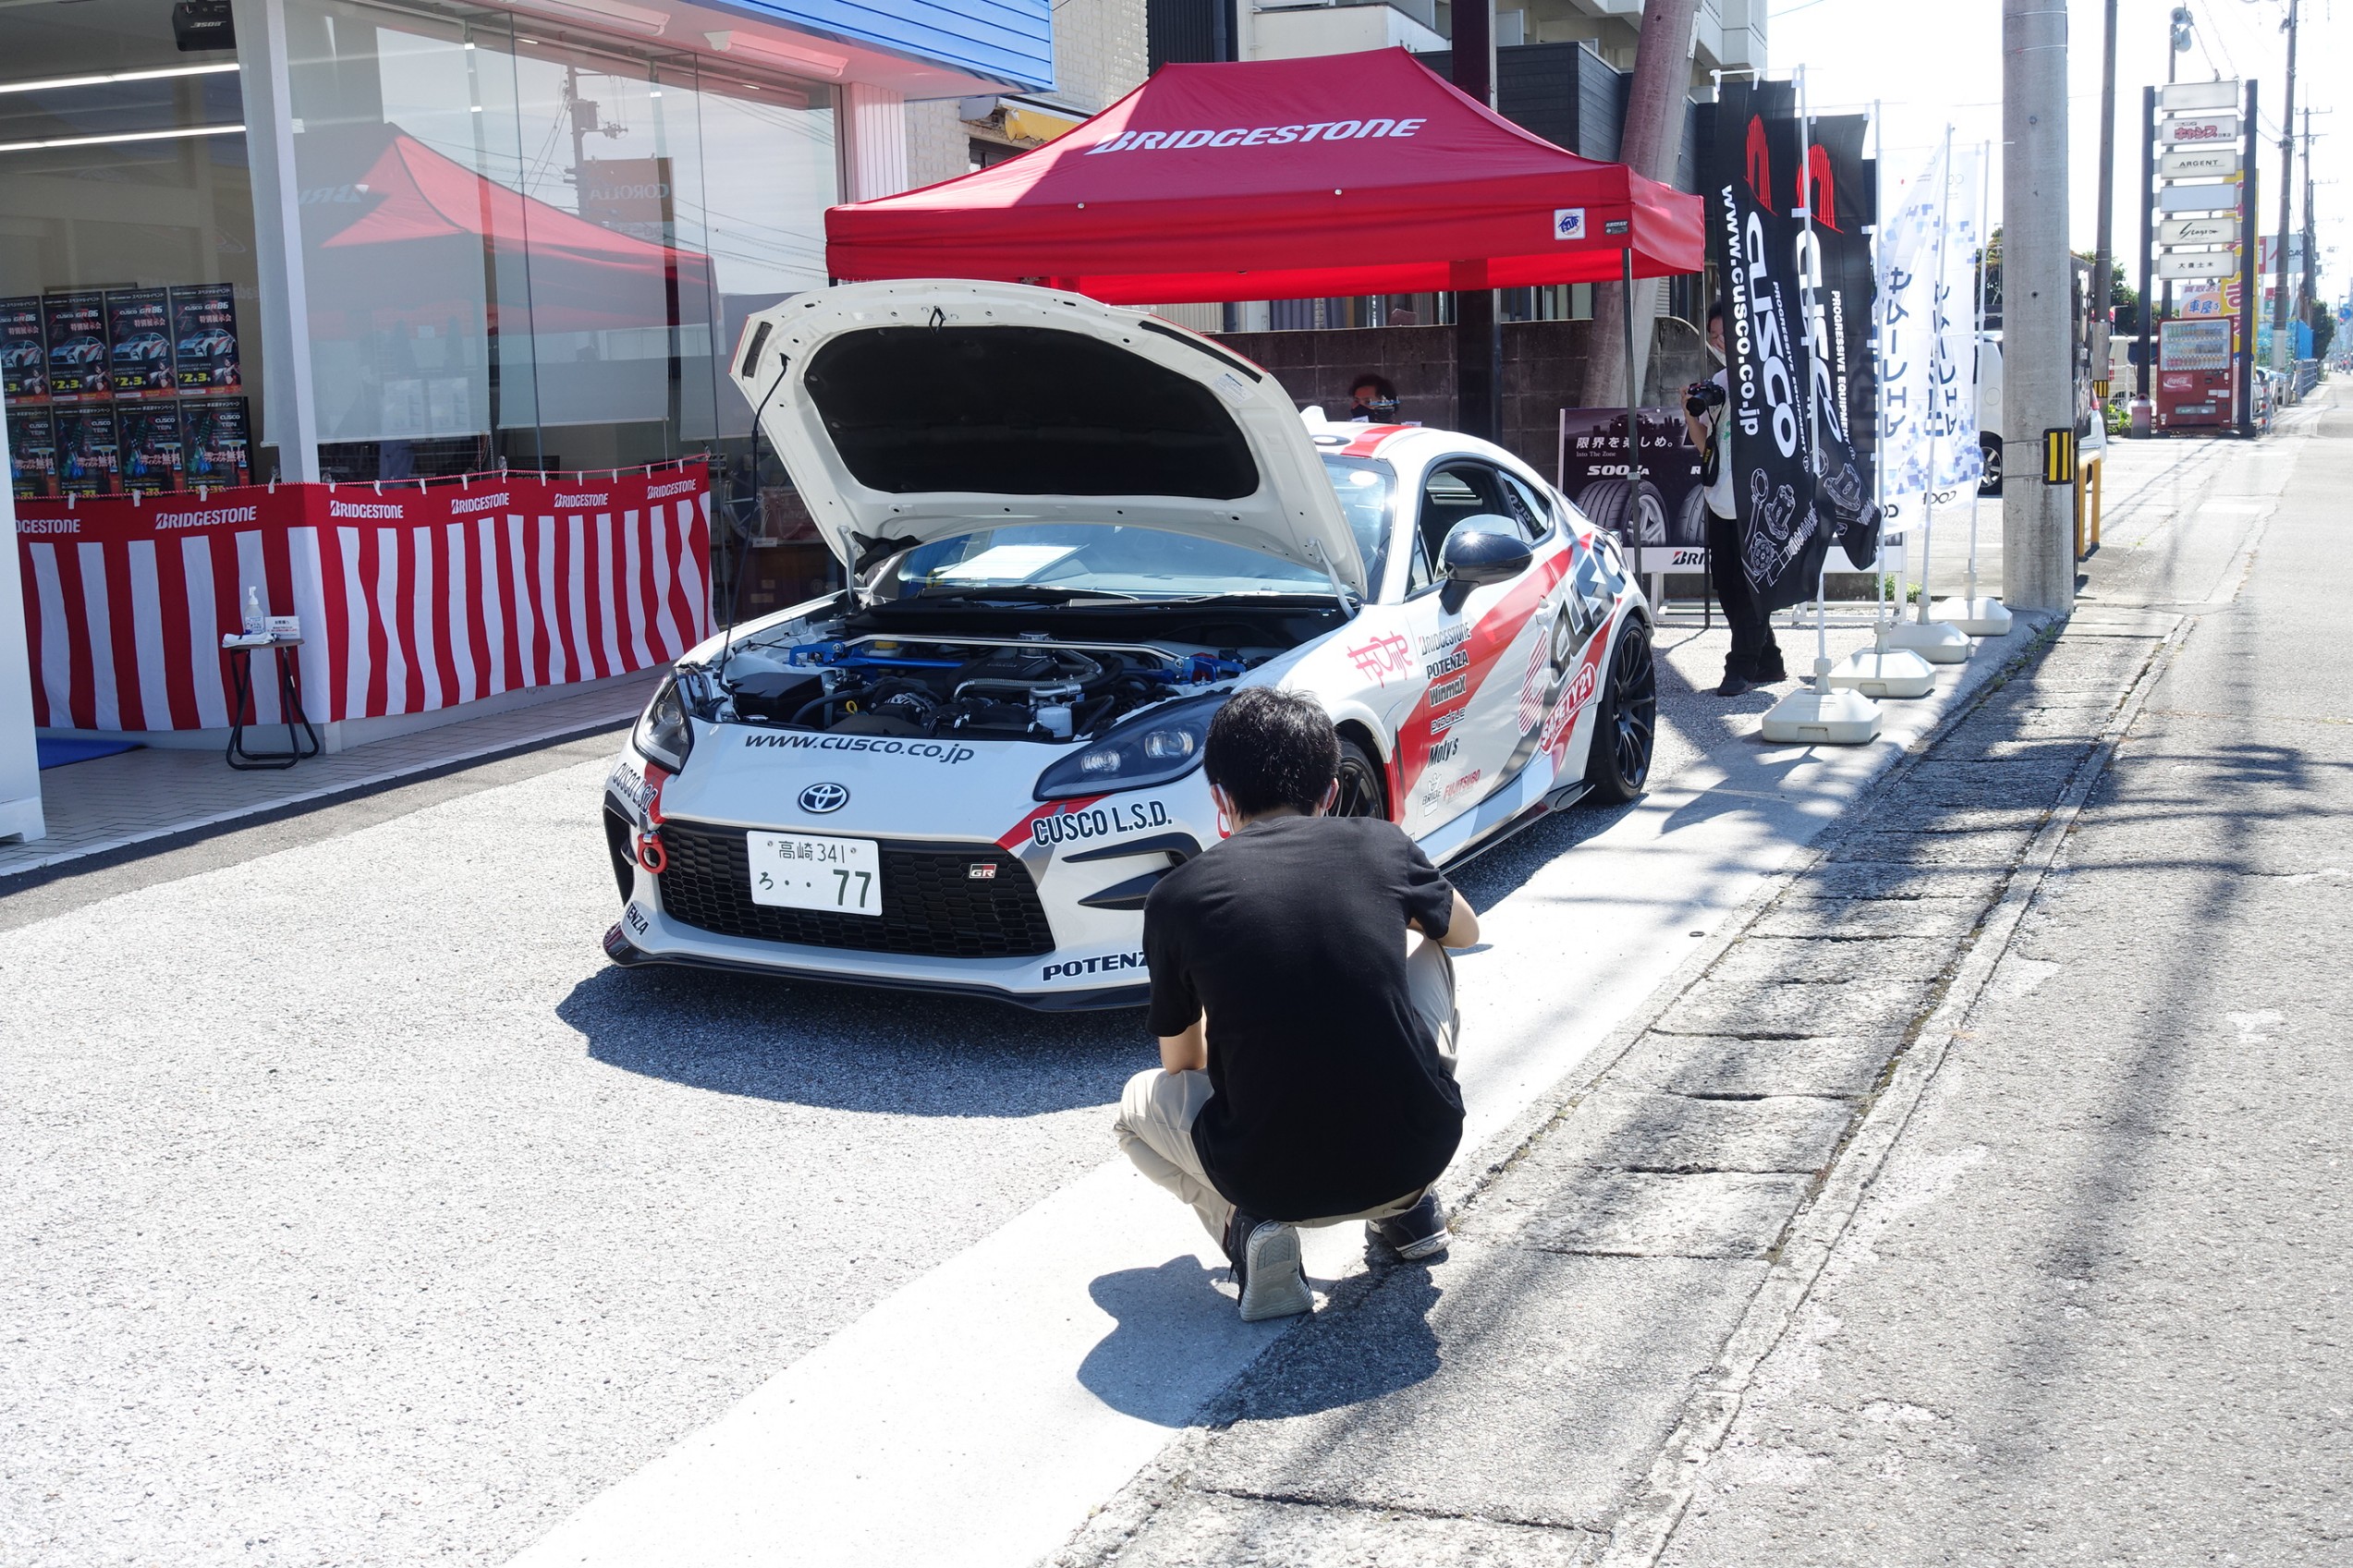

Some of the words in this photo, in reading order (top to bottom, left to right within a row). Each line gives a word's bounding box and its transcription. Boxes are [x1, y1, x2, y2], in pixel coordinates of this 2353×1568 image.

[1086, 117, 1426, 155] BRIDGESTONE
[2179, 159, 2218, 167] ARGENT
[1721, 184, 1761, 437] www.cusco.co.jp
[2188, 299, 2221, 314] 車屋さ
[1747, 212, 1797, 457] CUSCO
[1832, 290, 1847, 372] PROGRESSIVE
[1773, 281, 1795, 372] PROGRESSIVE
[1791, 375, 1808, 453] EQUIPMENT
[1836, 375, 1850, 446] EQUIPMENT
[451, 492, 509, 515] BRIDGESTONE
[555, 492, 608, 508] BRIDGESTONE
[648, 478, 697, 500] BRIDGESTONE
[154, 505, 257, 530] BRIDGESTONE
[330, 500, 404, 519] BRIDGESTONE
[1419, 622, 1470, 657] BRIDGESTONE
[1426, 650, 1469, 680] POTENZA
[745, 733, 975, 765] www.cusco.co.jp
[1428, 738, 1459, 768] Moty's
[612, 762, 642, 798] CUSCO
[1031, 808, 1108, 846] CUSCO
[1115, 800, 1173, 833] L.S.D.
[778, 840, 813, 862] 高崎
[817, 841, 847, 864] 341
[759, 871, 774, 892] ろ
[833, 869, 872, 908] 77
[971, 868, 995, 878] GR
